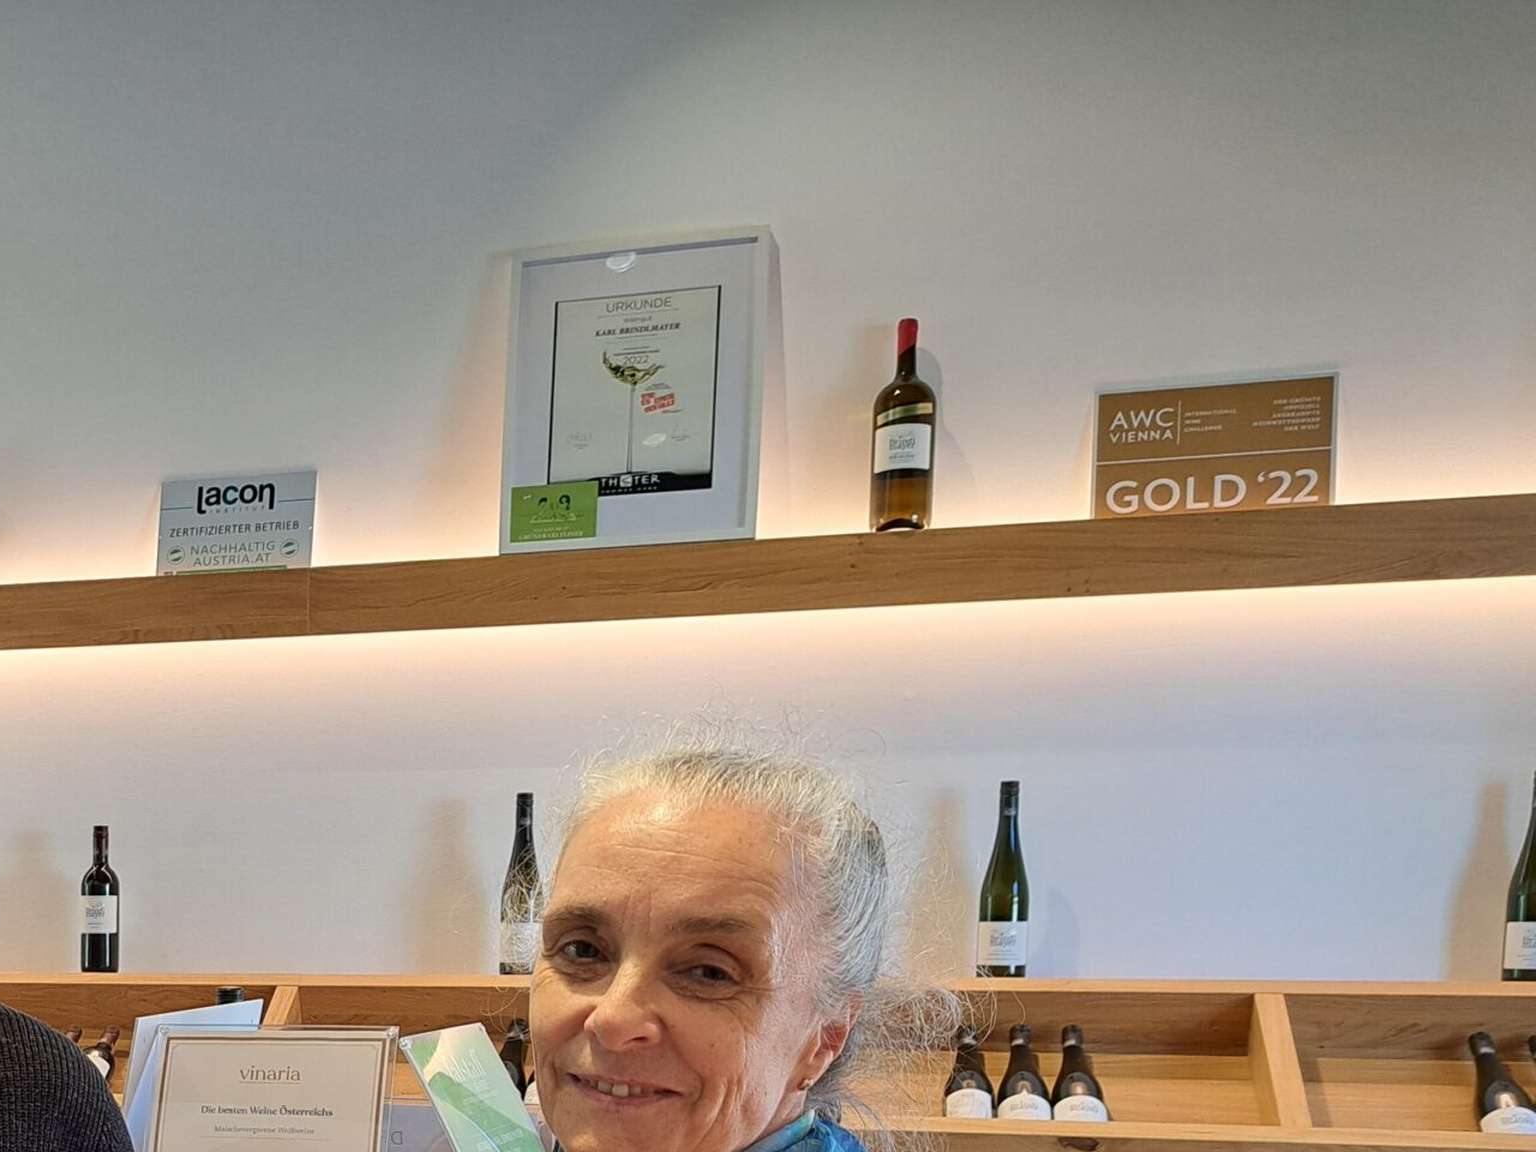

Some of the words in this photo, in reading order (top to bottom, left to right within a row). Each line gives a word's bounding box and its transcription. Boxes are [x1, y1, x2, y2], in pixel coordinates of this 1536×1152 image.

[606, 296, 672, 313] URKUNDE
[595, 328, 617, 337] KARL
[1108, 407, 1175, 431] AWC
[1109, 429, 1174, 444] VIENNA
[196, 482, 276, 515] lacon
[1106, 473, 1247, 514] GOLD
[169, 523, 252, 538] ZERTIFIZIERTER
[254, 520, 300, 533] BETRIEB
[190, 541, 276, 556] NACHHALTIG
[193, 552, 272, 567] AUSTRIA.AT
[239, 1064, 302, 1082] vinaria
[200, 1105, 216, 1115] Die
[217, 1105, 248, 1115] besten
[250, 1106, 278, 1116] Weine
[279, 1104, 334, 1117] Österreichs
